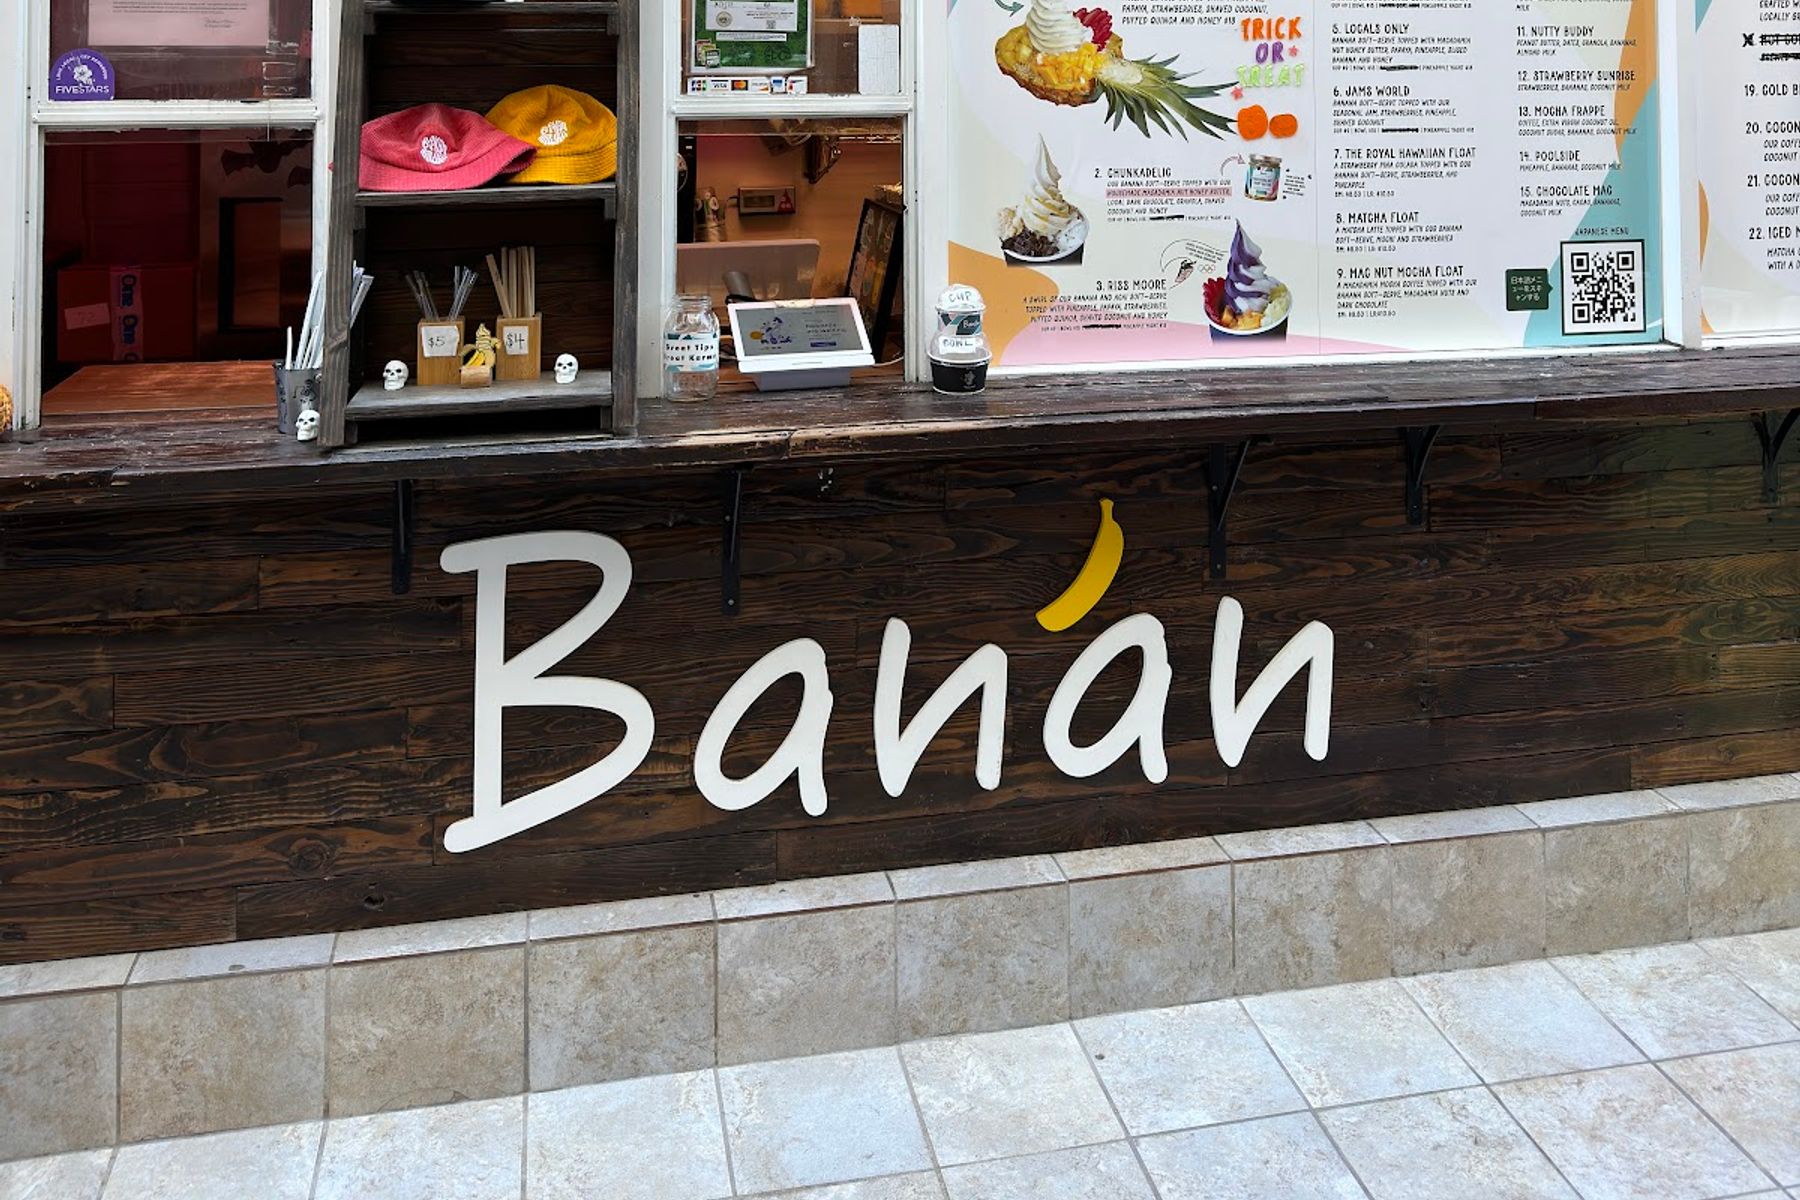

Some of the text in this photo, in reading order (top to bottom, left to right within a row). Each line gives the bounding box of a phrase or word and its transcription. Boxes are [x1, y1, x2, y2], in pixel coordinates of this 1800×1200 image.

[1241, 16, 1302, 41] TRICK
[1345, 23, 1381, 35] LOCALS
[1384, 23, 1410, 35] ONLY
[1516, 25, 1594, 37] 11. NUTTY BUDDY
[1255, 41, 1284, 64] OR
[1236, 63, 1305, 88] TREAT
[1518, 70, 1636, 81] 12. STRAWBERRY SUNRISE
[55, 85, 110, 94] FIVESTARS
[1333, 85, 1410, 97] 6. JAMS WORLD
[1744, 84, 1788, 97] 19. COLD
[1518, 105, 1605, 117] 13. MOCHA FRAPPE
[1745, 121, 1762, 134] 20.
[1334, 147, 1476, 159] 7. THE ROYAL HAWAIIAN FLOAT
[1519, 150, 1580, 162] 14. POOLSIDE
[1764, 152, 1798, 162] COCONUT
[1094, 167, 1172, 179] 2. CHUNKADELIC
[1747, 174, 1761, 187] 21.
[1520, 186, 1532, 198] 15.
[1536, 185, 1590, 197] CHOCOLATE
[1336, 211, 1419, 224] 8. MATCHA FLOAT
[1575, 226, 1629, 236] JAPANESE MENU
[1749, 226, 1791, 240] 22. ICED
[1337, 268, 1346, 279] 9.
[1374, 267, 1393, 278] NUT
[1397, 266, 1431, 278] MOCHA
[1435, 265, 1463, 277] FLOAT
[1096, 280, 1105, 291] 3.
[1132, 279, 1167, 290] MOORE
[949, 290, 972, 302] CUP
[428, 335, 446, 348] $5
[505, 332, 525, 349] $4
